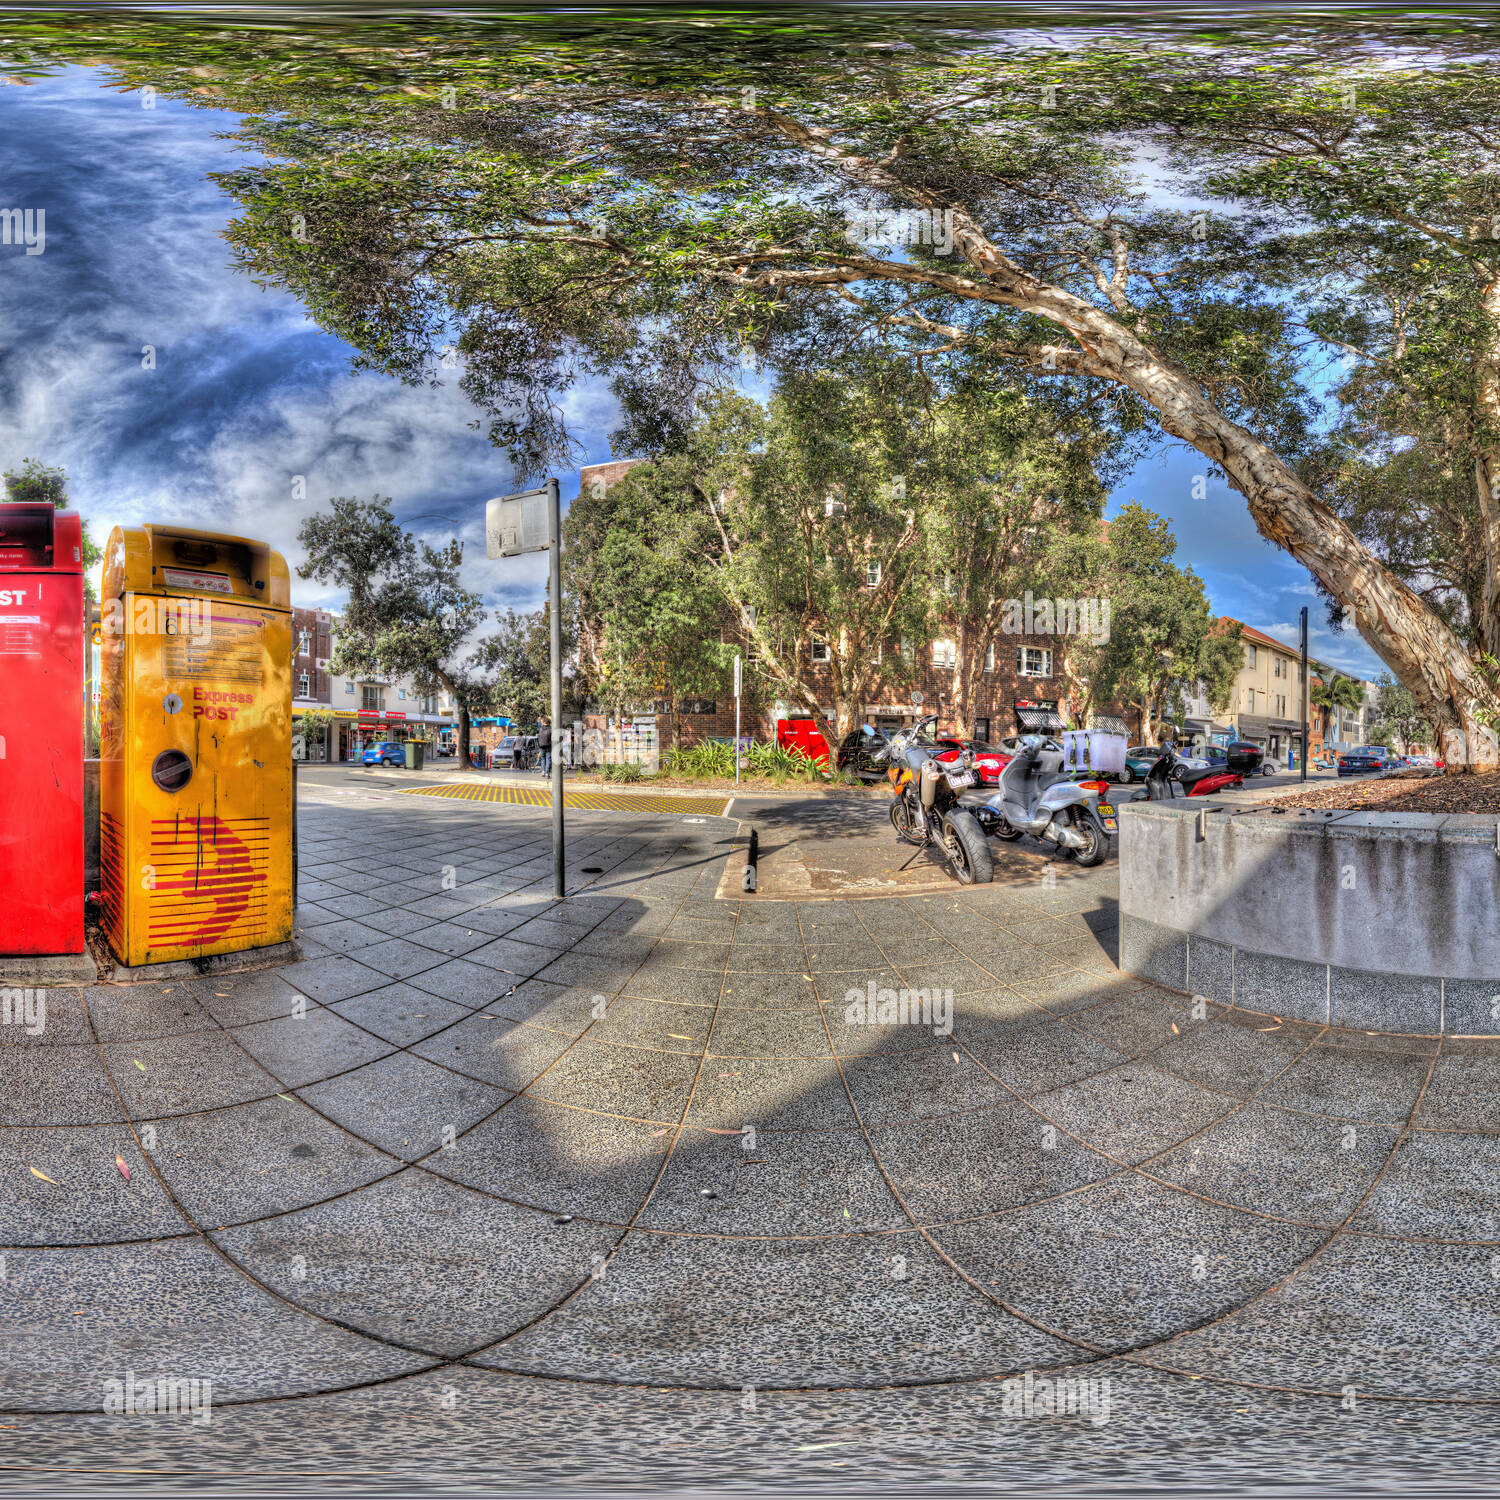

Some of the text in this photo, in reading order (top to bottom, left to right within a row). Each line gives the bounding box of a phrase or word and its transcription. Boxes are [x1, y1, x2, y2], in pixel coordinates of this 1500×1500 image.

[166, 618, 177, 636] 6
[194, 688, 254, 704] Express
[194, 706, 238, 720] POST
